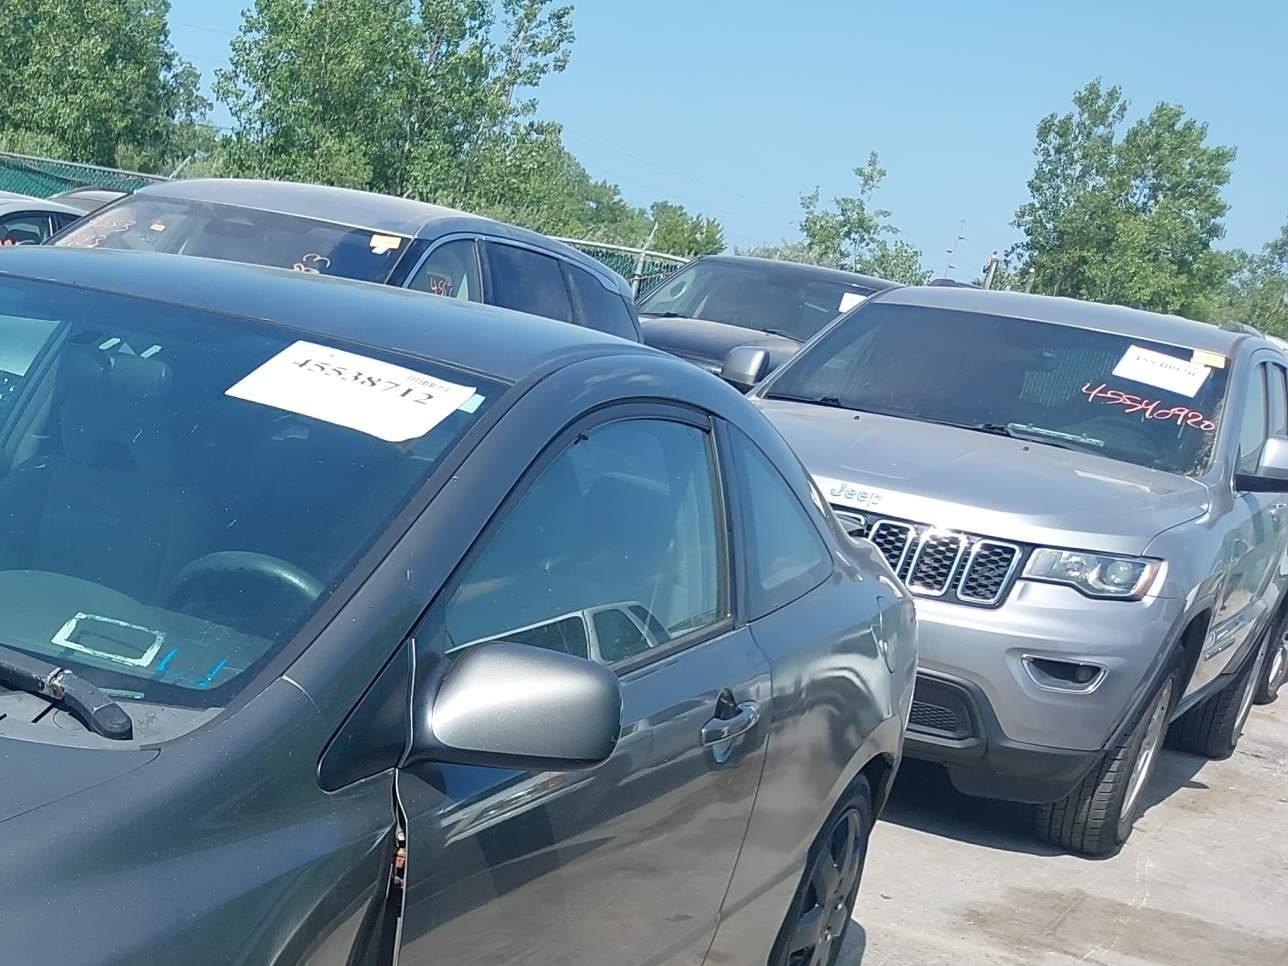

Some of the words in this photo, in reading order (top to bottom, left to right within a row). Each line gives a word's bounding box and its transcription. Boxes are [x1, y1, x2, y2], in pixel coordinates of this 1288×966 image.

[292, 357, 434, 405] 45538712
[1081, 382, 1217, 431] 45540920
[829, 482, 883, 507] Jeep
